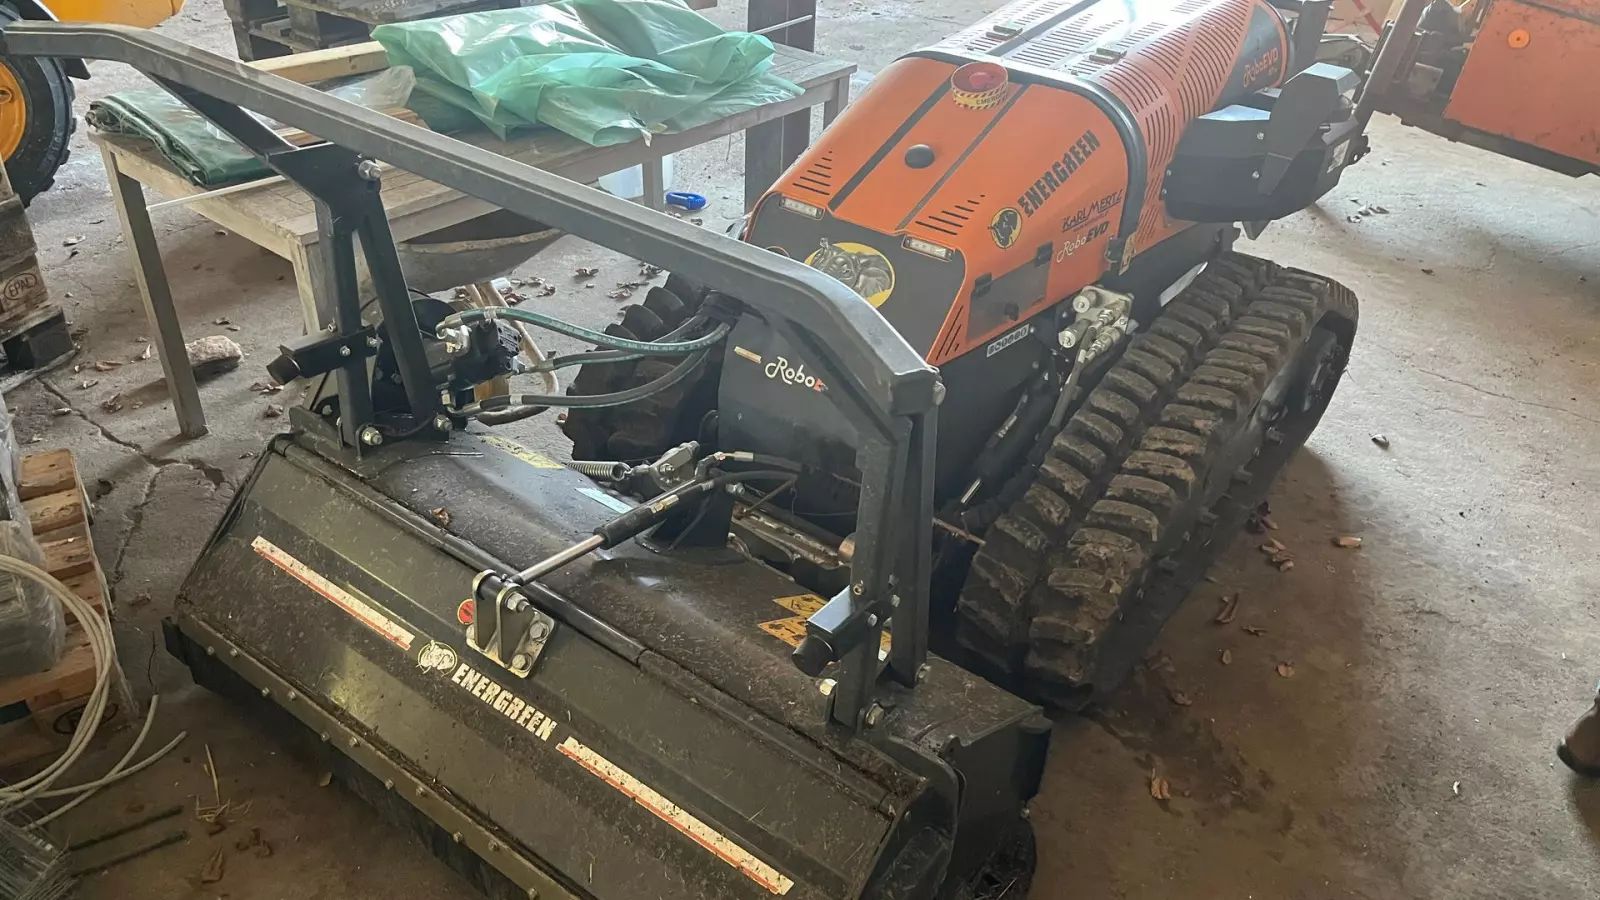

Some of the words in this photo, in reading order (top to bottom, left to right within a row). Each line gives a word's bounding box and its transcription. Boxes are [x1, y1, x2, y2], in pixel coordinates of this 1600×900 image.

[1018, 129, 1101, 218] ENERGREEN
[1061, 207, 1089, 233] KARL
[1056, 221, 1110, 263] RoboEVO
[8, 276, 36, 298] EPAL
[451, 662, 559, 742] ENERGREEN
